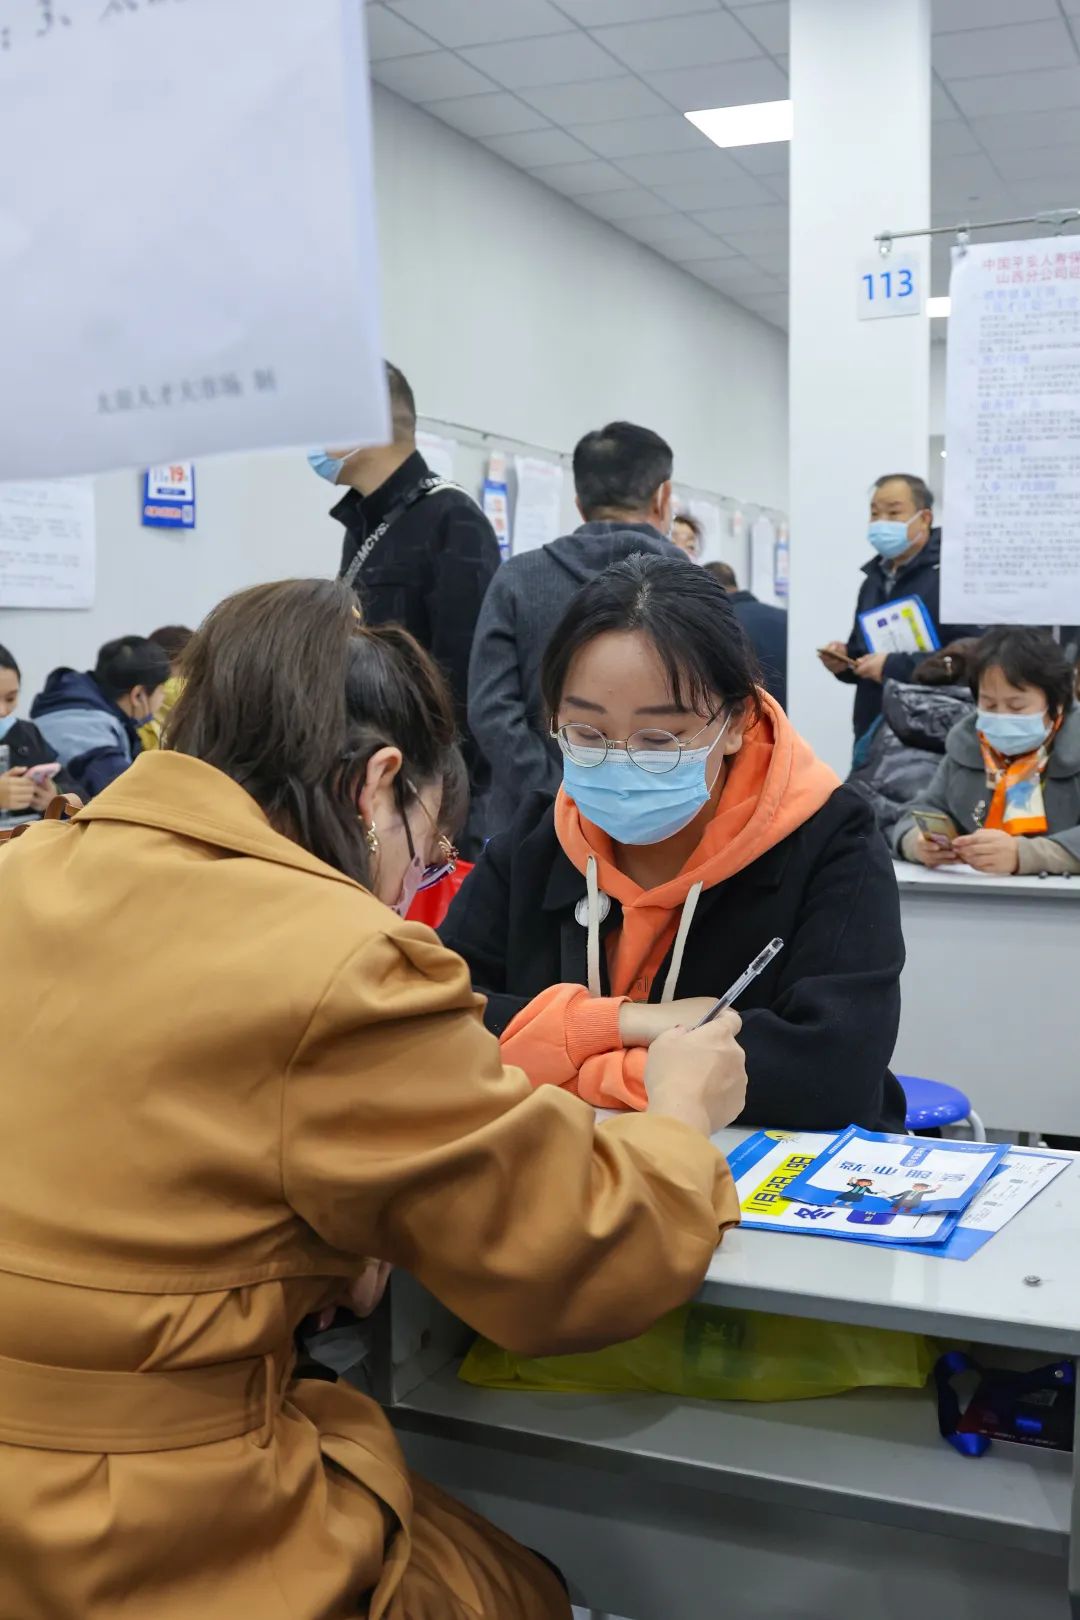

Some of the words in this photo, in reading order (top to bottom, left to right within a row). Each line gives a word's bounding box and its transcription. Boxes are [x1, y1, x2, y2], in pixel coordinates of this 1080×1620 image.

[862, 269, 914, 301] 113
[839, 1161, 966, 1182] 就业服务
